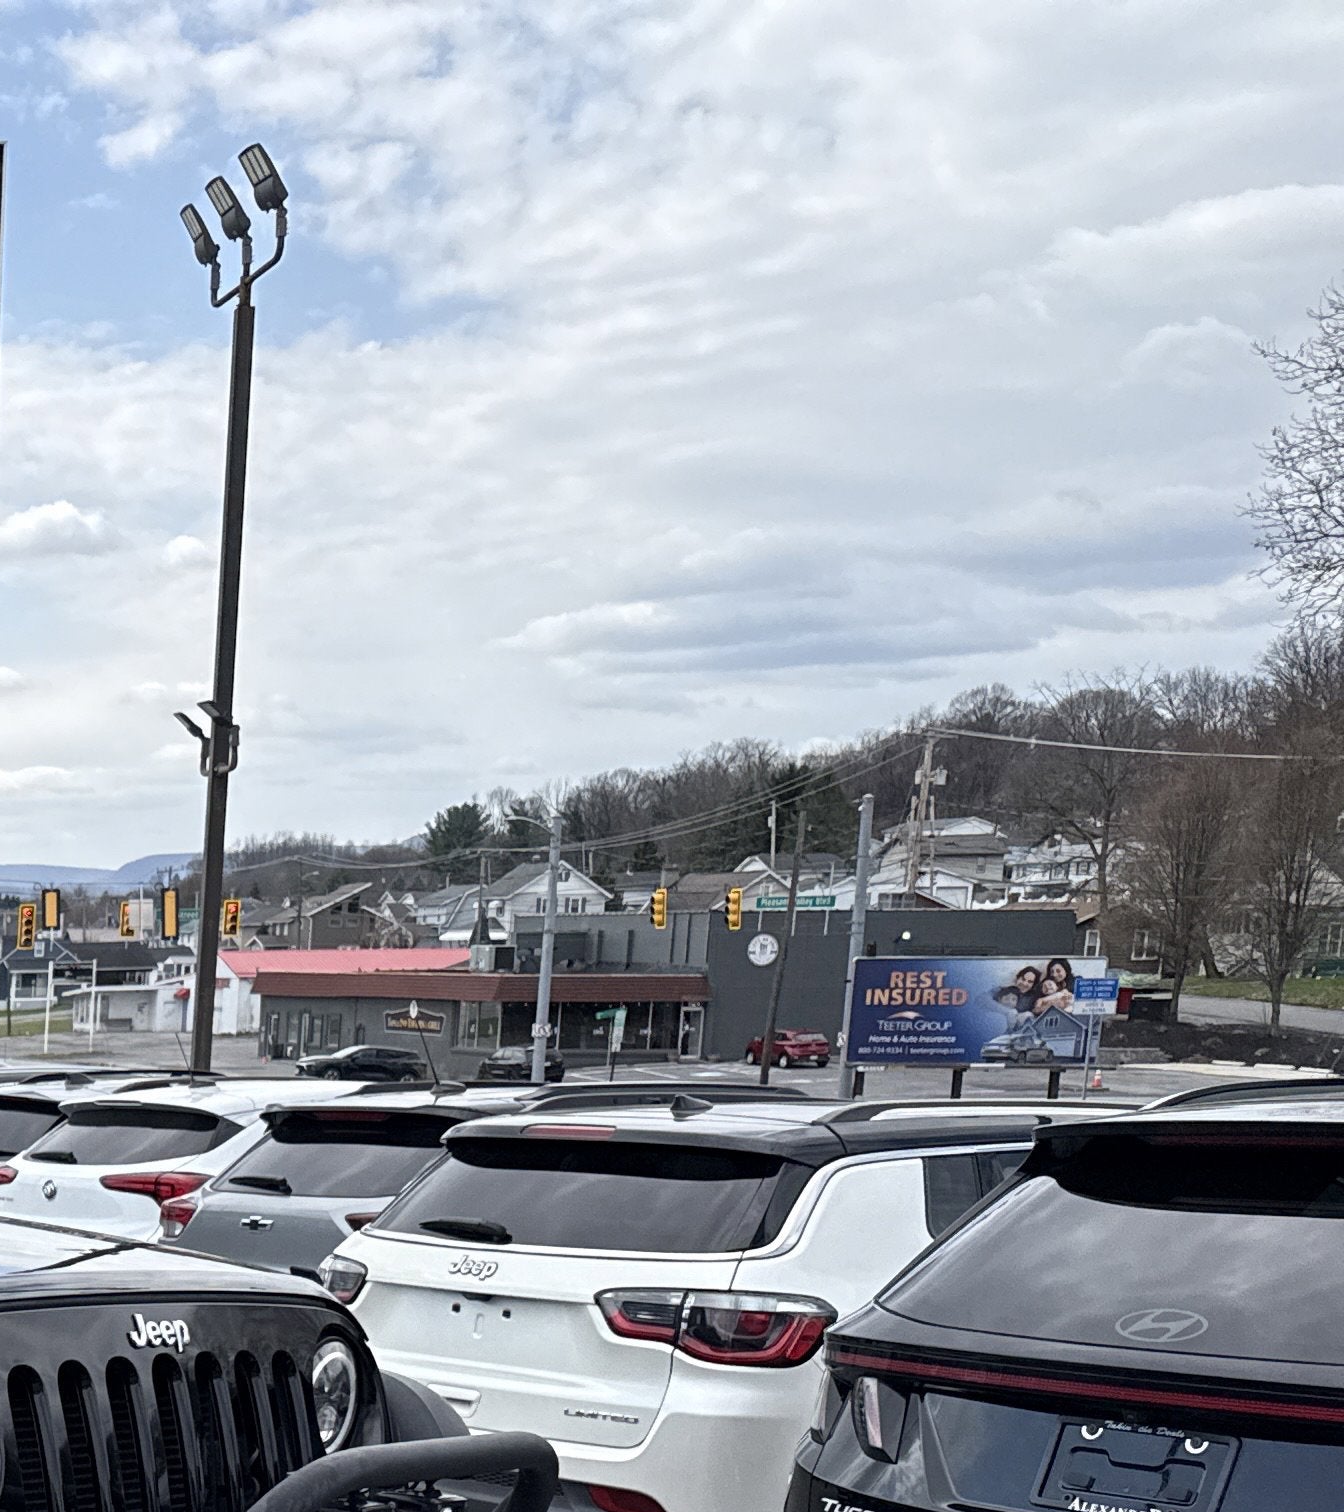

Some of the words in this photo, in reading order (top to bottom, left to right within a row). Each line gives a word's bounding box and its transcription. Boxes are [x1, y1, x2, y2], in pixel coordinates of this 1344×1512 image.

[890, 971, 947, 988] REST
[865, 988, 969, 1006] INSURED
[448, 1254, 499, 1281] Jeep
[128, 1313, 190, 1353] Jeep
[564, 1407, 639, 1424] LIMITED
